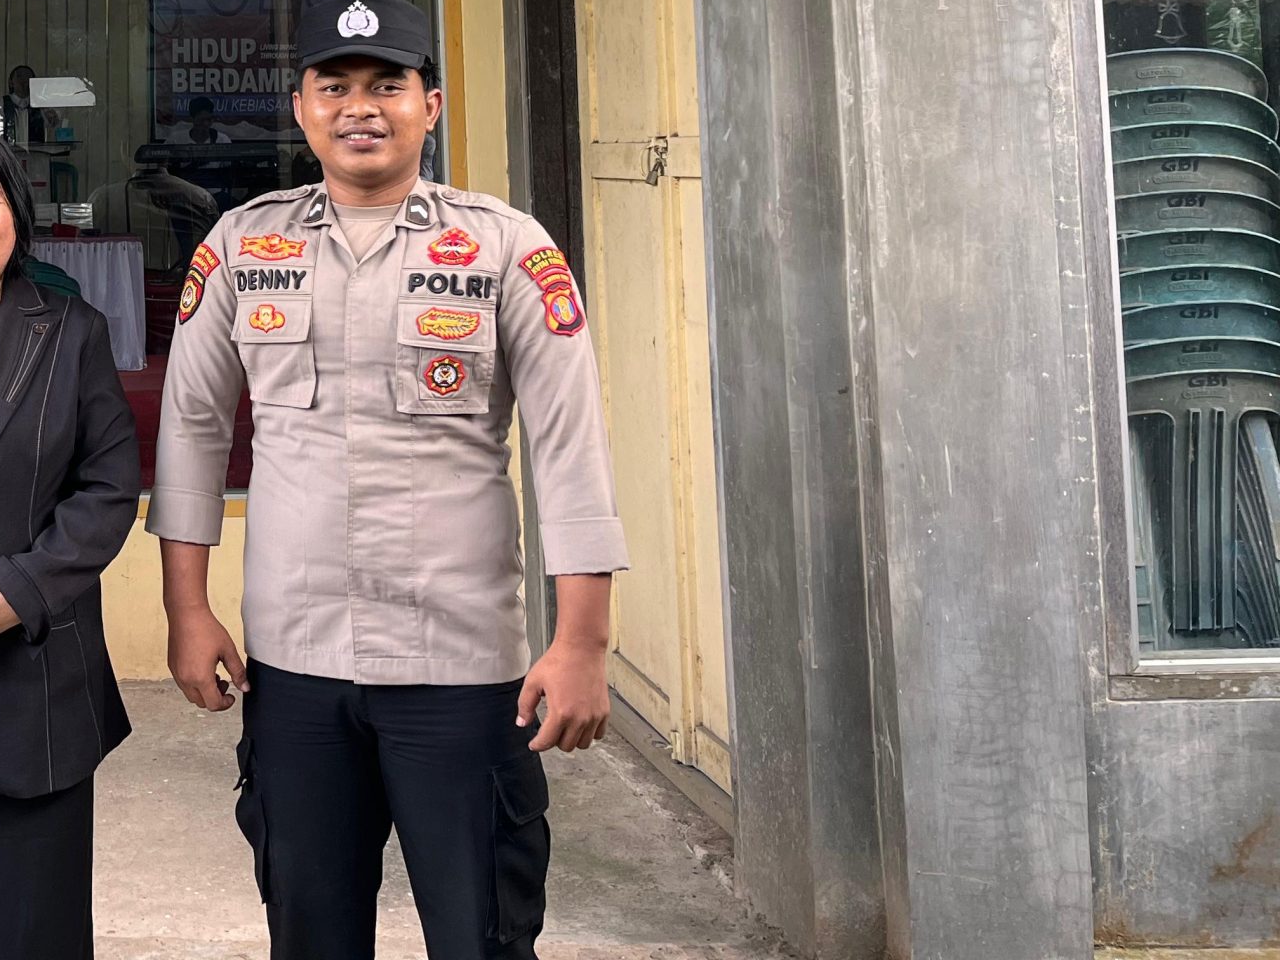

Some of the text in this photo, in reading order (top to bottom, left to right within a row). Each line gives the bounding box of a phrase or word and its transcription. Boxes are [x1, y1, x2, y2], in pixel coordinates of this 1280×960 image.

[172, 38, 257, 64] HIDUP
[171, 68, 298, 93] BERDAMP
[231, 98, 290, 111] KEBIASAA
[1161, 159, 1200, 172] GBI
[1166, 195, 1206, 208] GBI
[236, 269, 307, 292] DENNY
[408, 273, 493, 299] POLRI
[1179, 306, 1219, 319] GBI
[1188, 375, 1228, 388] GBI
